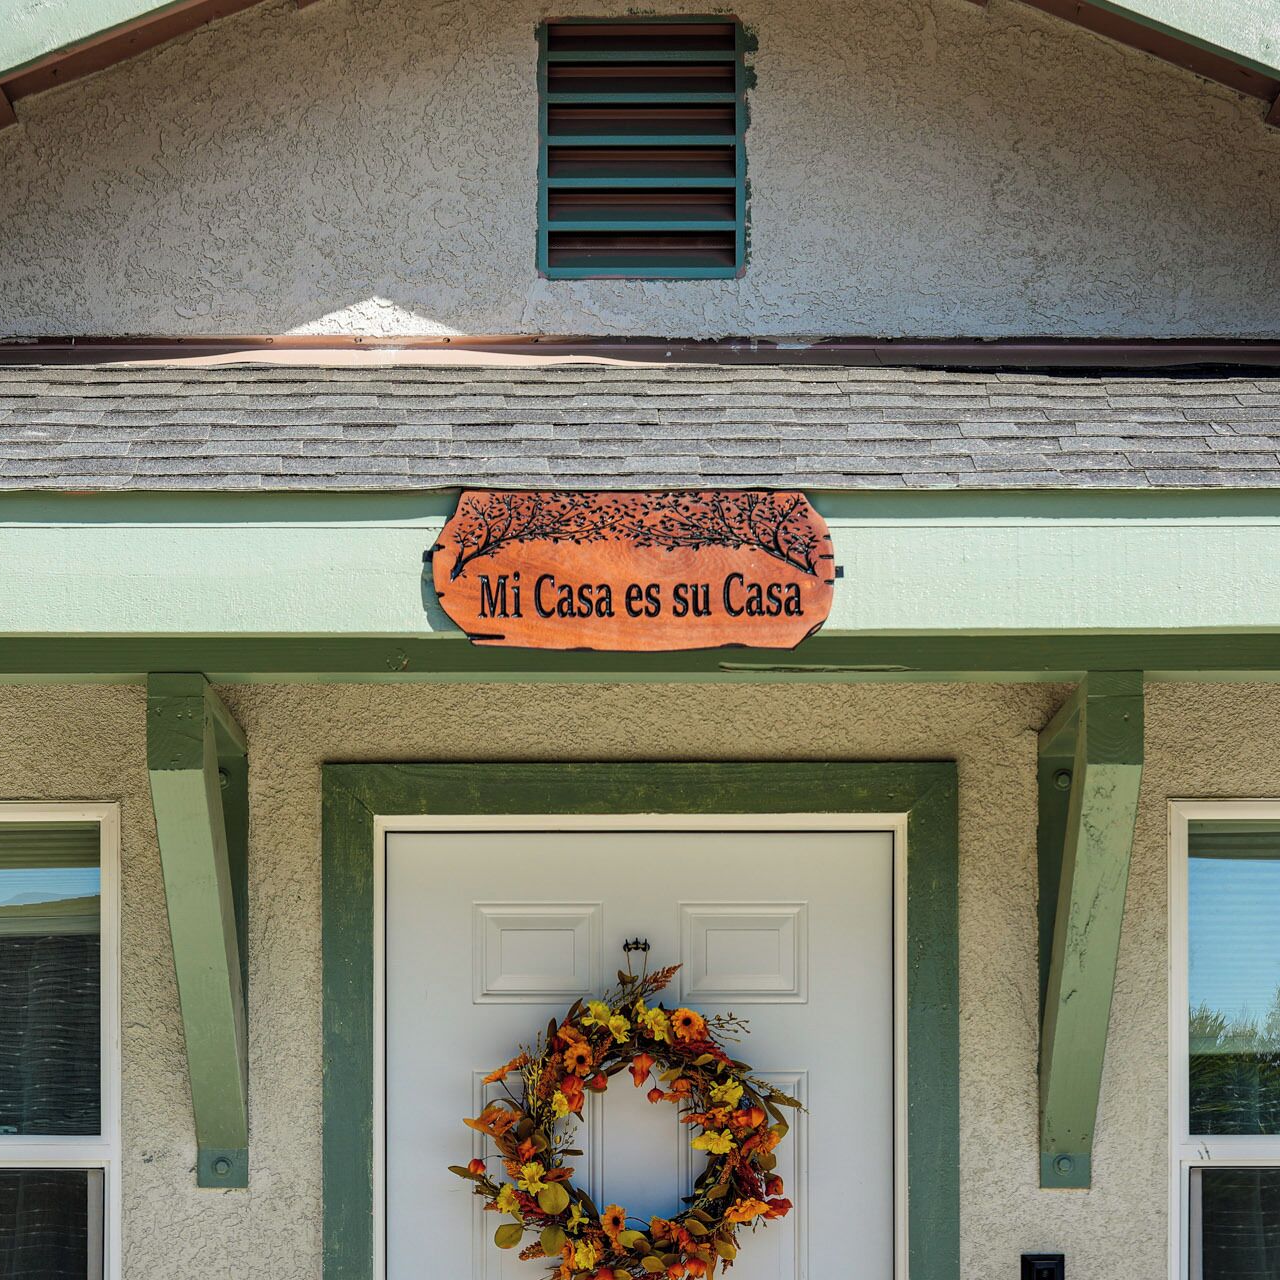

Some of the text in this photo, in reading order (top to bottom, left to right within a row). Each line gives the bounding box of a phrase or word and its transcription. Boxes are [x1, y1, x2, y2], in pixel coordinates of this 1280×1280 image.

[478, 571, 803, 618] Mi Casa es su Casa
